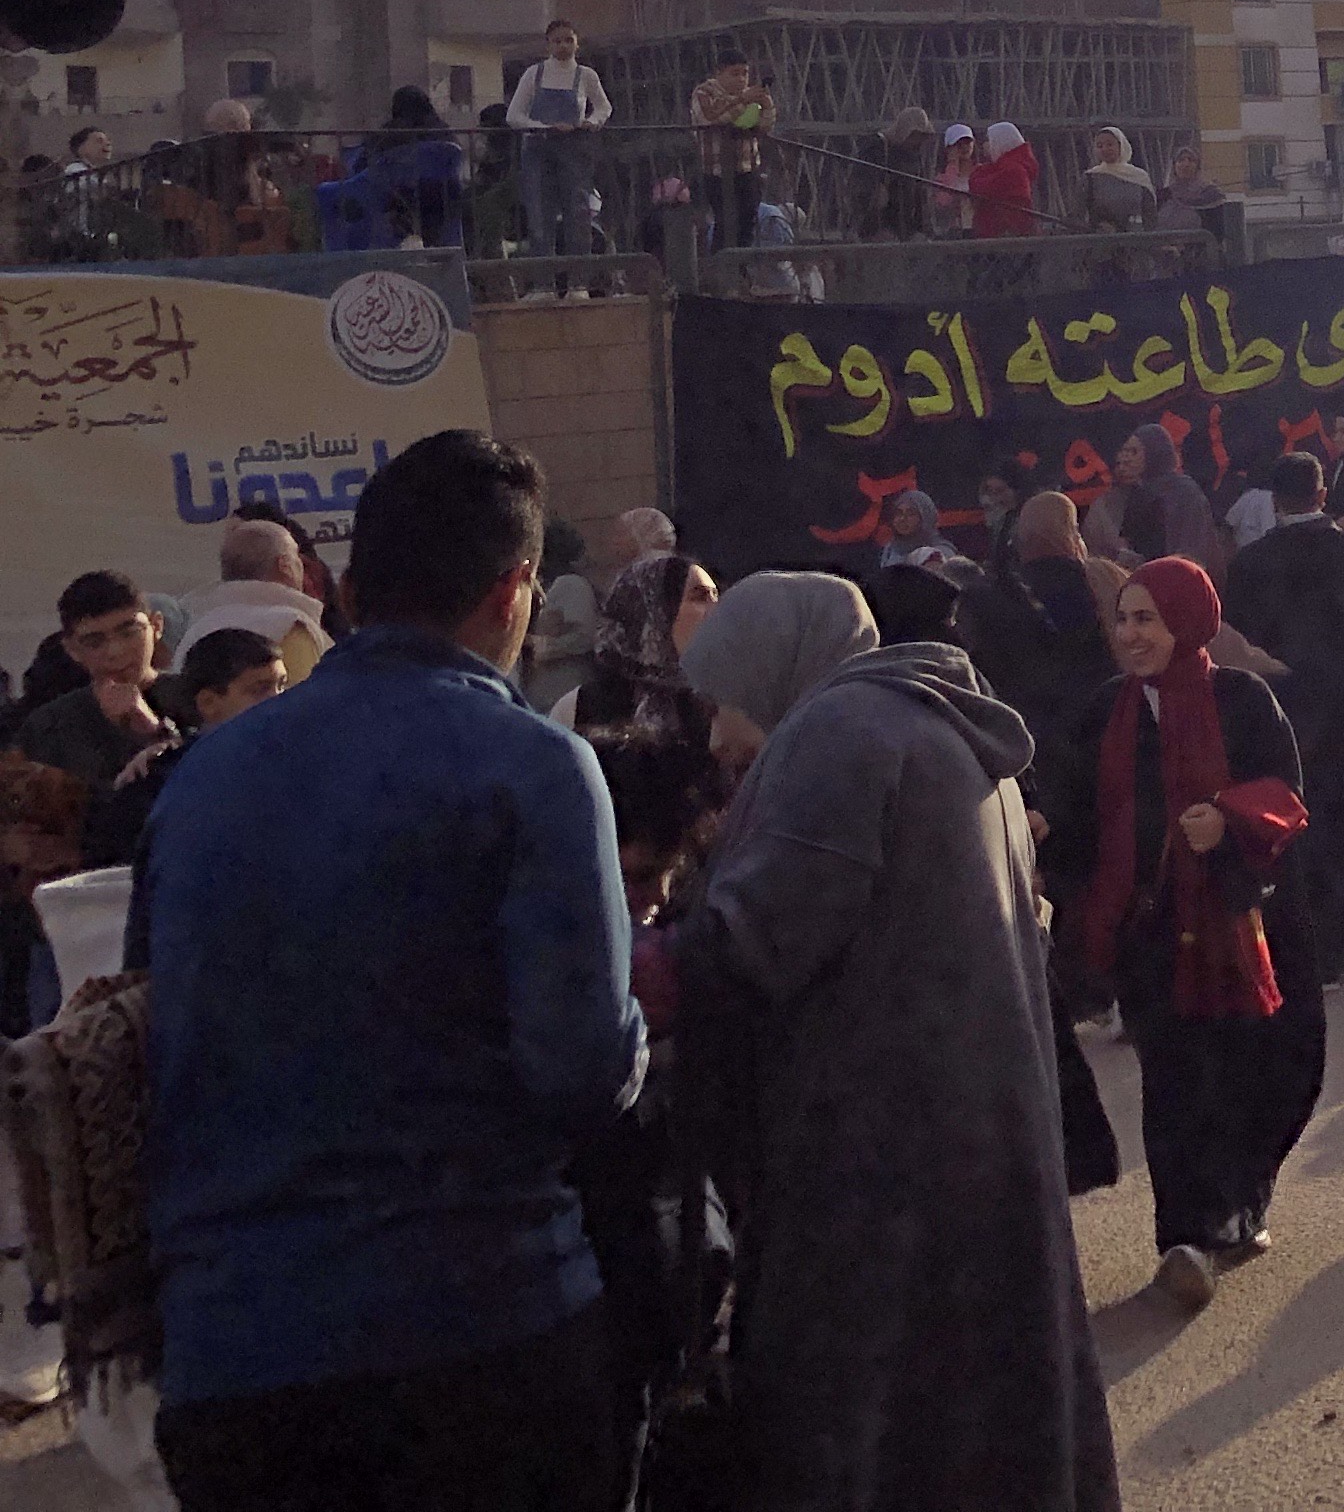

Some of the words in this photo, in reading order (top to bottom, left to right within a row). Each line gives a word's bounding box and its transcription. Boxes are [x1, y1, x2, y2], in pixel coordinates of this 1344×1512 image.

[769, 309, 986, 459] أدوم
[1005, 286, 1285, 406] طاعته
[170, 438, 391, 525] عدونا
[234, 430, 359, 475] نساندهم
